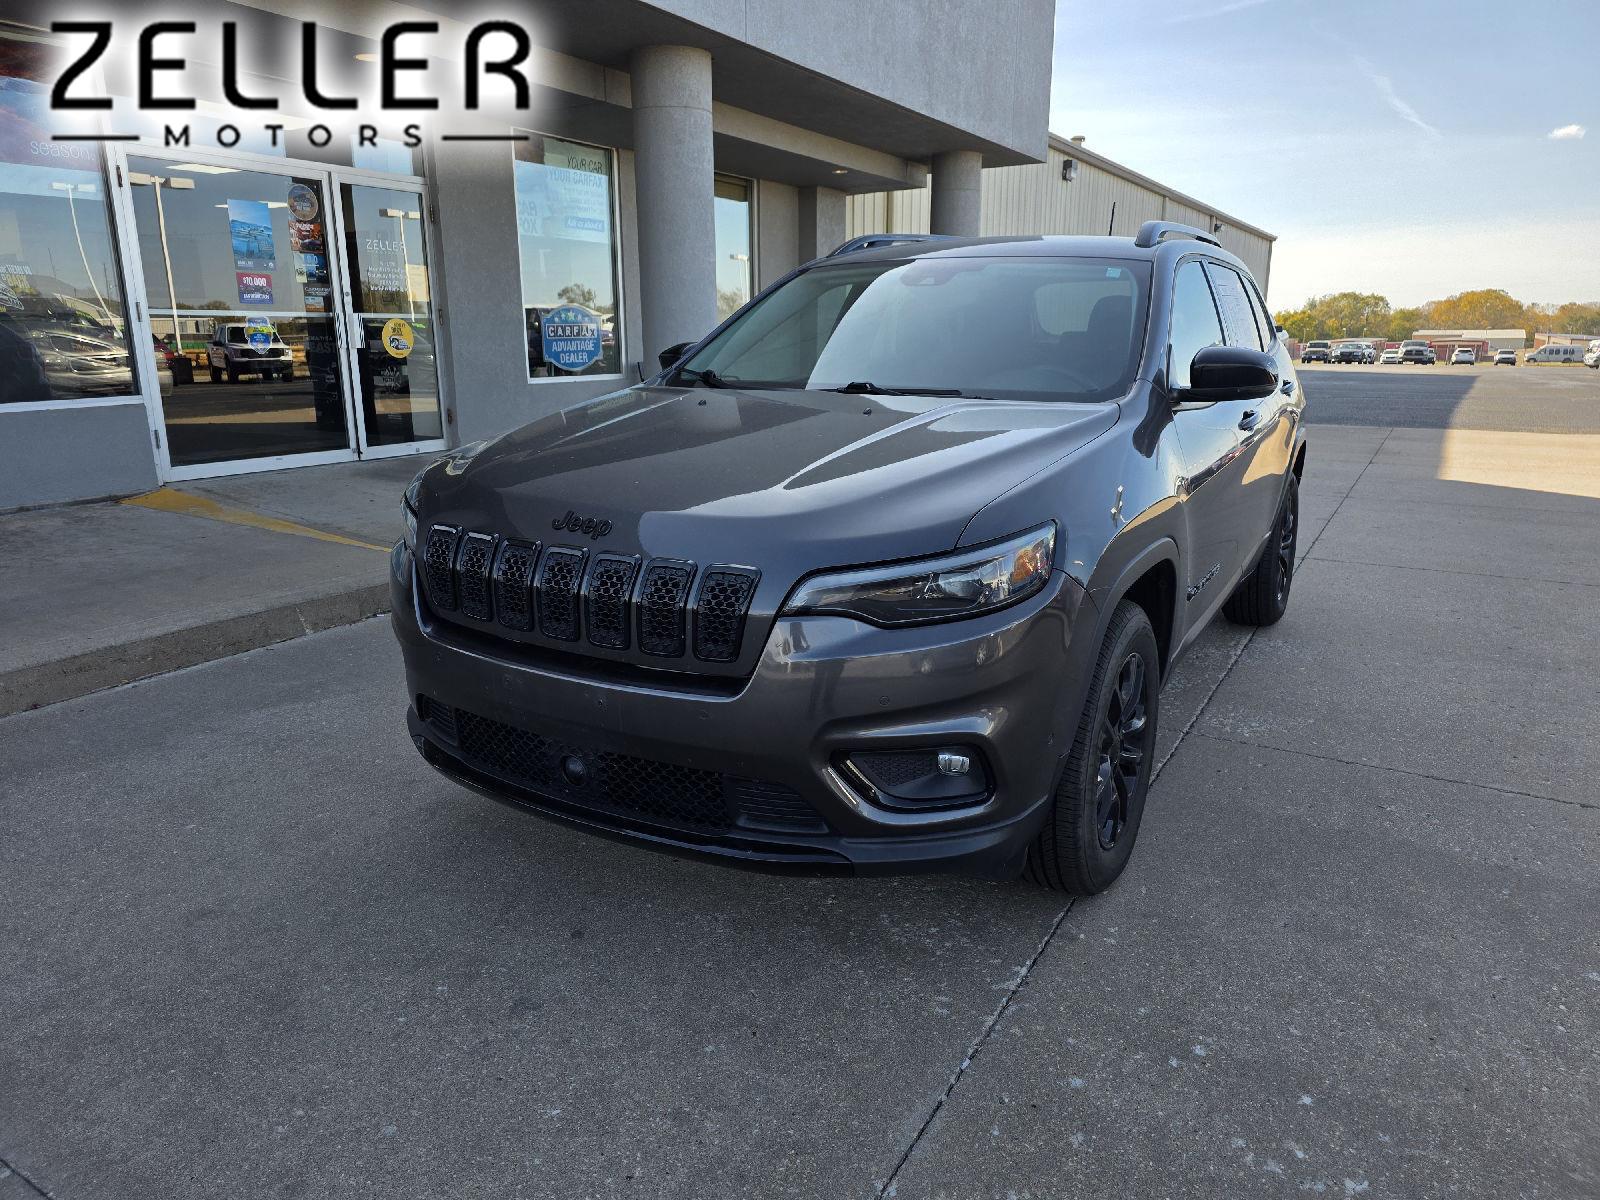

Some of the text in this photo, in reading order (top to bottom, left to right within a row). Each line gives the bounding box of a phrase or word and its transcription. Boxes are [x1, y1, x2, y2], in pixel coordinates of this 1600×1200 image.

[30, 140, 96, 160] season.
[567, 155, 587, 170] YOUR
[547, 325, 596, 337] CARFAX
[552, 341, 595, 352] ADVANTAGE
[560, 352, 589, 363] DEALER
[552, 510, 613, 541] Jeep
